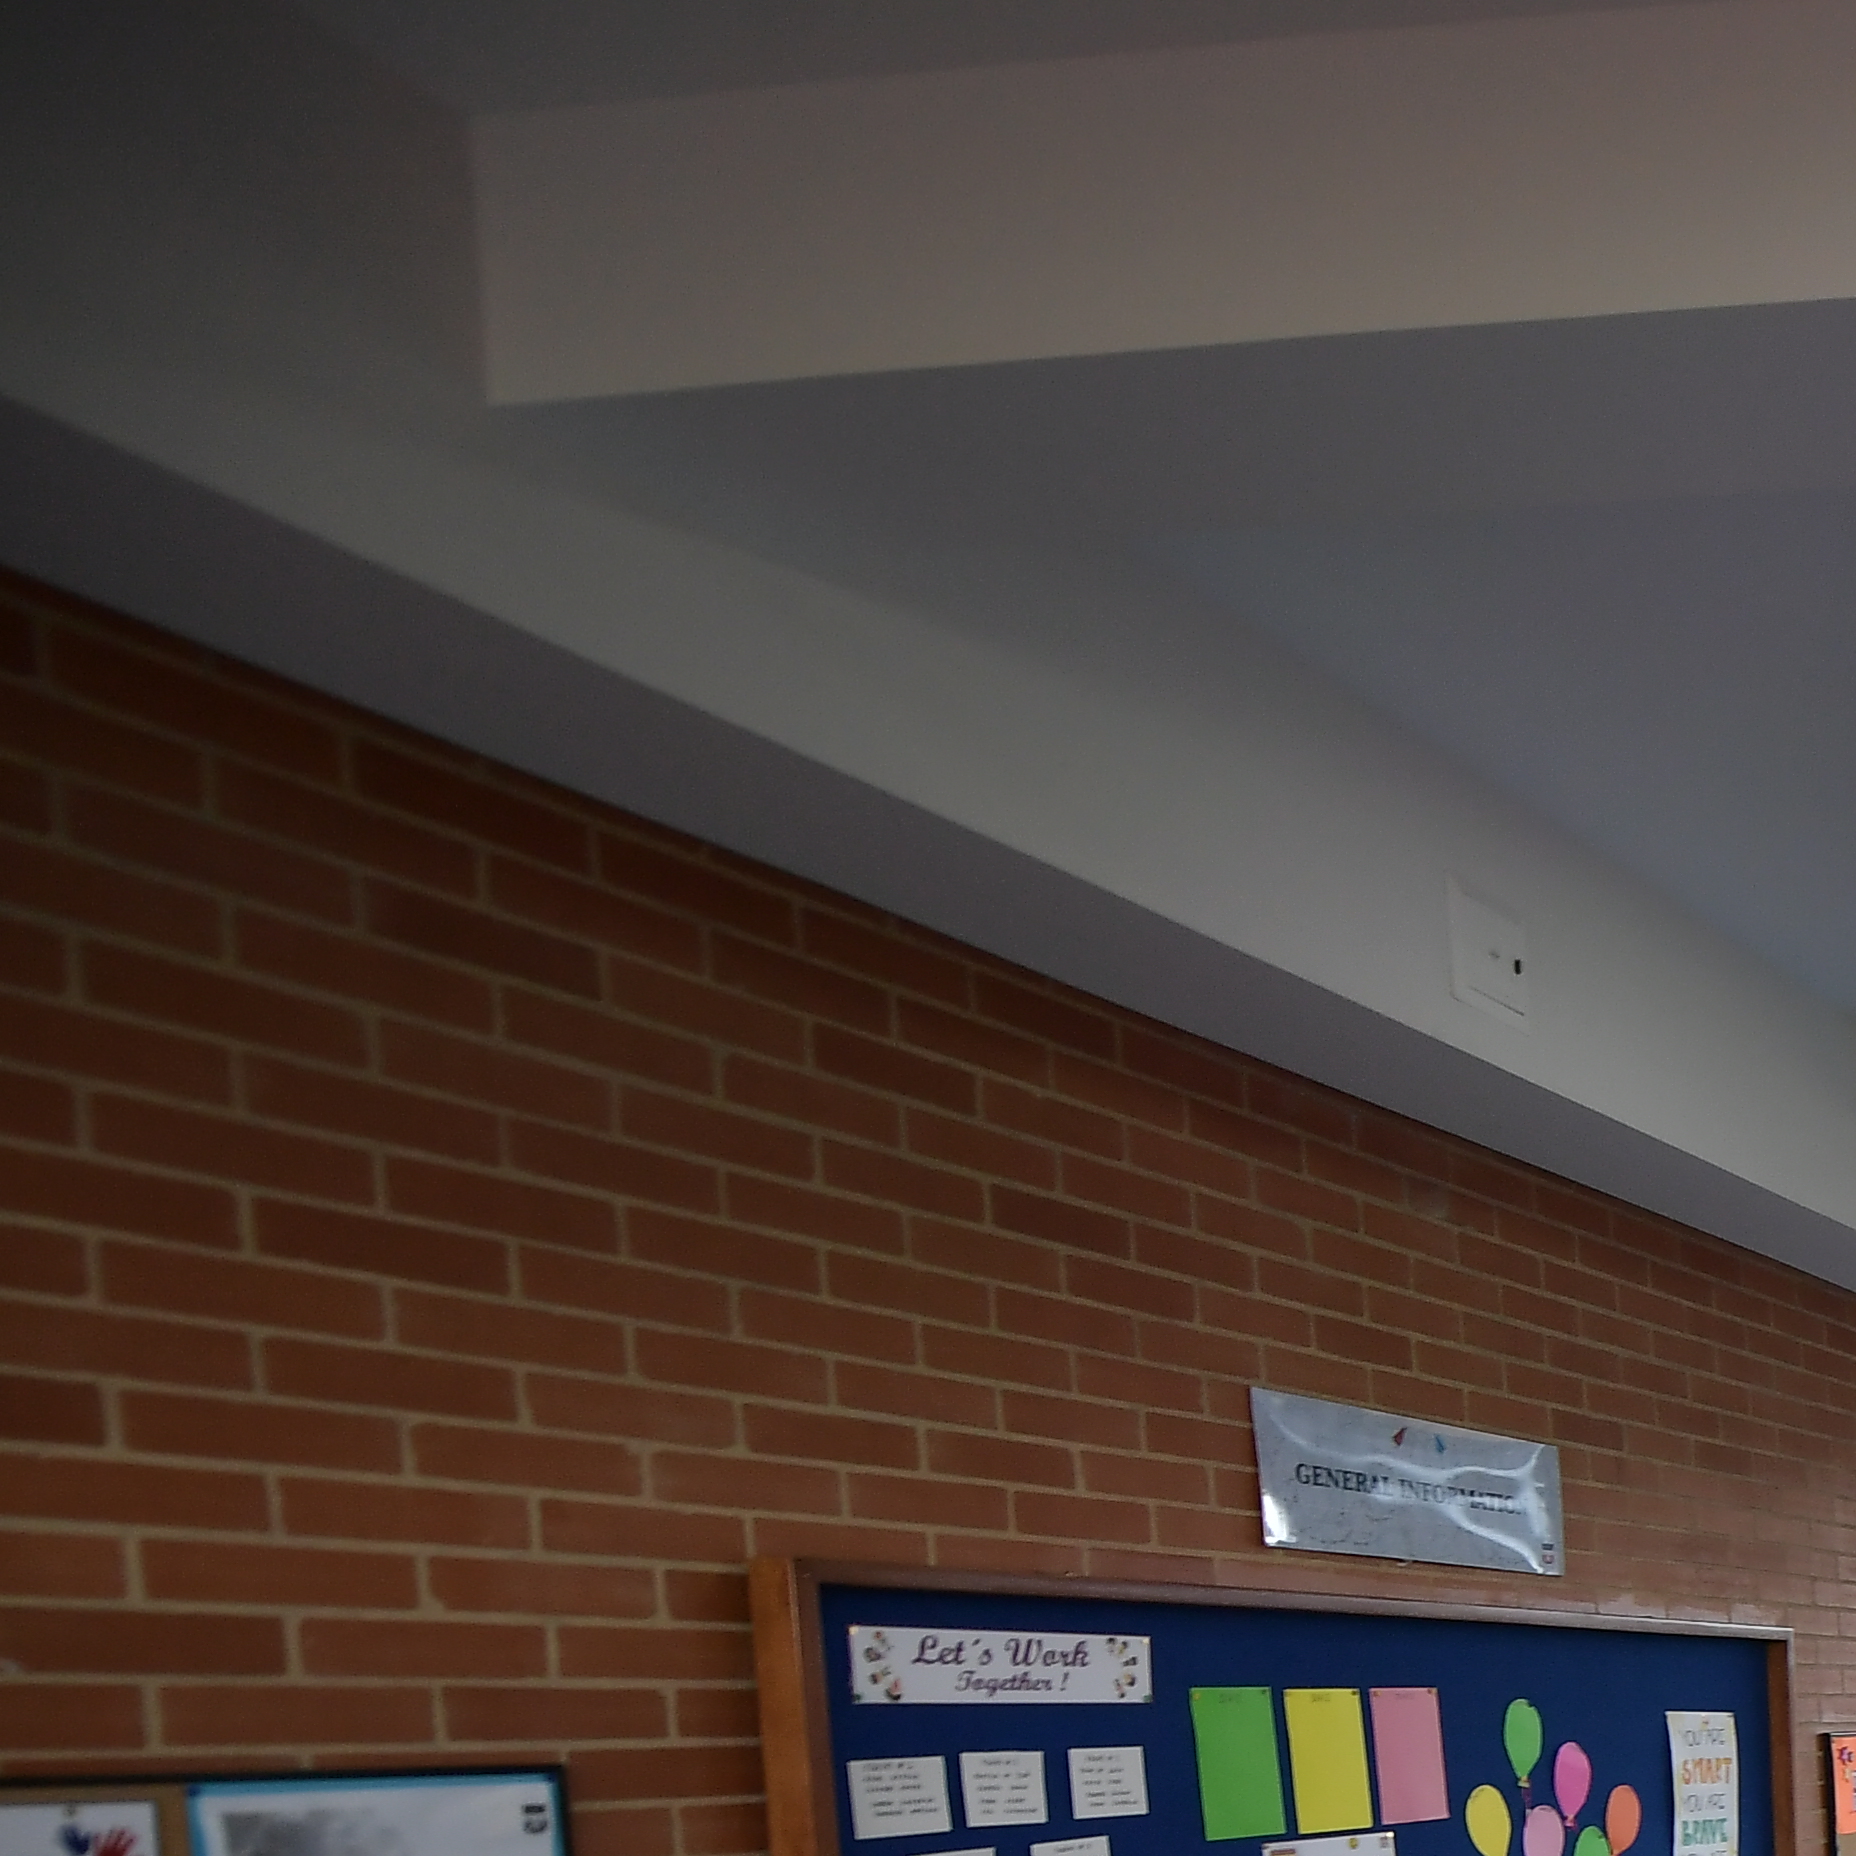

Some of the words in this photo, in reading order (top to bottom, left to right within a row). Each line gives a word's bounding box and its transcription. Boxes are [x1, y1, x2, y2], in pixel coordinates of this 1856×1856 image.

[1296, 1463, 1394, 1497] GENERAL
[1398, 1478, 1528, 1516] INFORMATIO
[1004, 1638, 1090, 1667] Work
[1681, 1757, 1733, 1786] SMART
[1681, 1817, 1728, 1847] BRAVE
